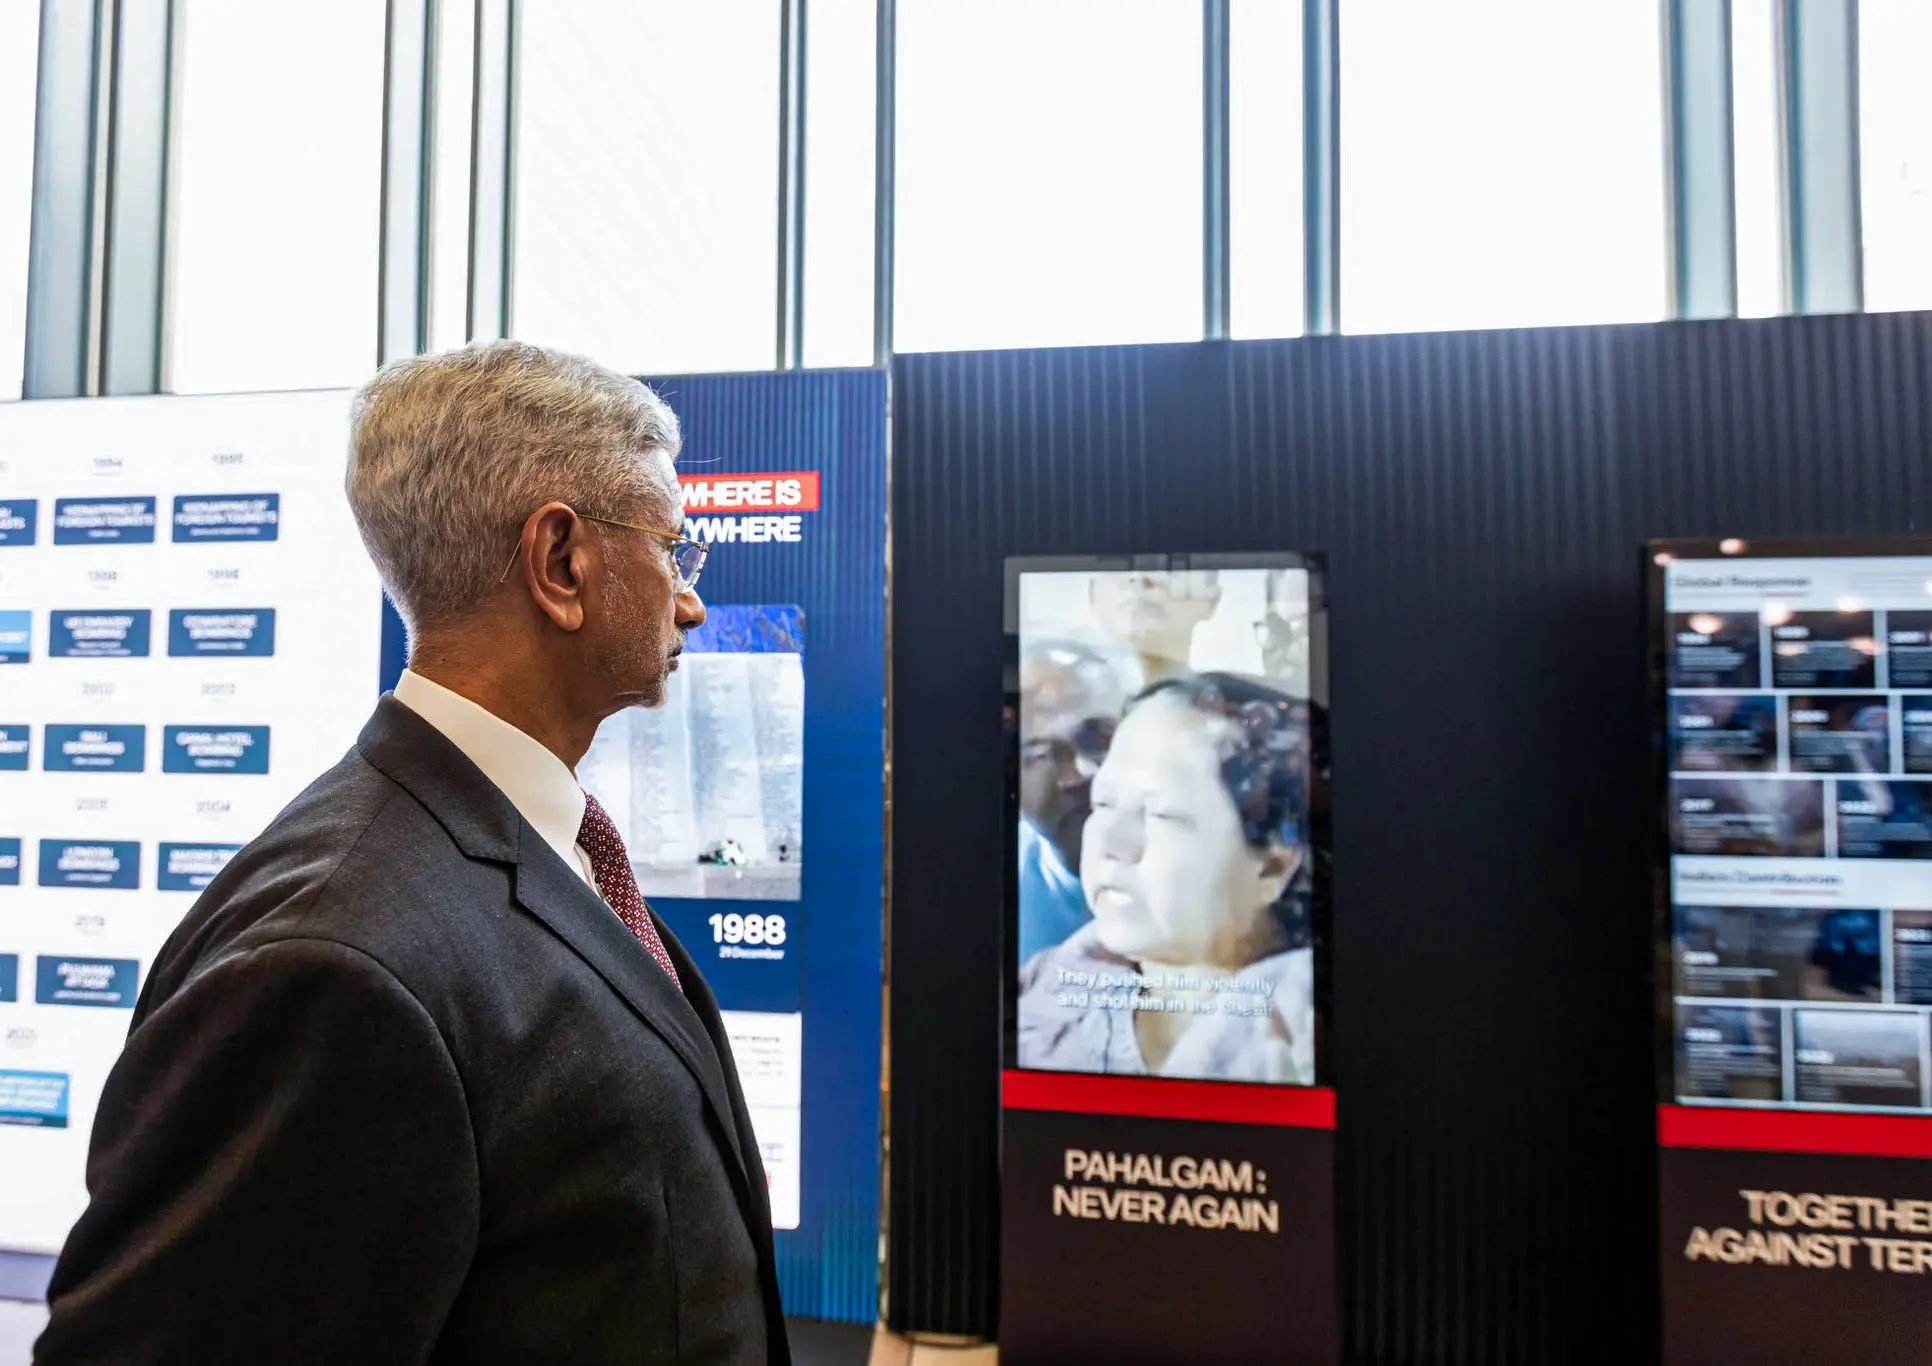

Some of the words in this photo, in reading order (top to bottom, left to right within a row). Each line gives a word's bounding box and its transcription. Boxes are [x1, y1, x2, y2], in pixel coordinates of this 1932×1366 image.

[776, 479, 802, 505] IS
[683, 516, 802, 543] YWHERE
[708, 913, 786, 945] 1988
[732, 945, 785, 960] December
[1056, 967, 1098, 991] They
[1102, 971, 1161, 993] pushed
[1164, 971, 1201, 992] him
[1204, 976, 1277, 1000] violently
[1057, 991, 1089, 1008] and
[1094, 994, 1129, 1010] shot
[1131, 995, 1165, 1012] him
[1167, 999, 1186, 1014] in
[1191, 998, 1219, 1015] the
[1053, 1185, 1165, 1225] NEVER
[1168, 1194, 1279, 1233] AGAIN
[1739, 1189, 1932, 1234] TOGETHE
[1684, 1226, 1859, 1270] AGAINST
[1861, 1237, 1932, 1275] TER
